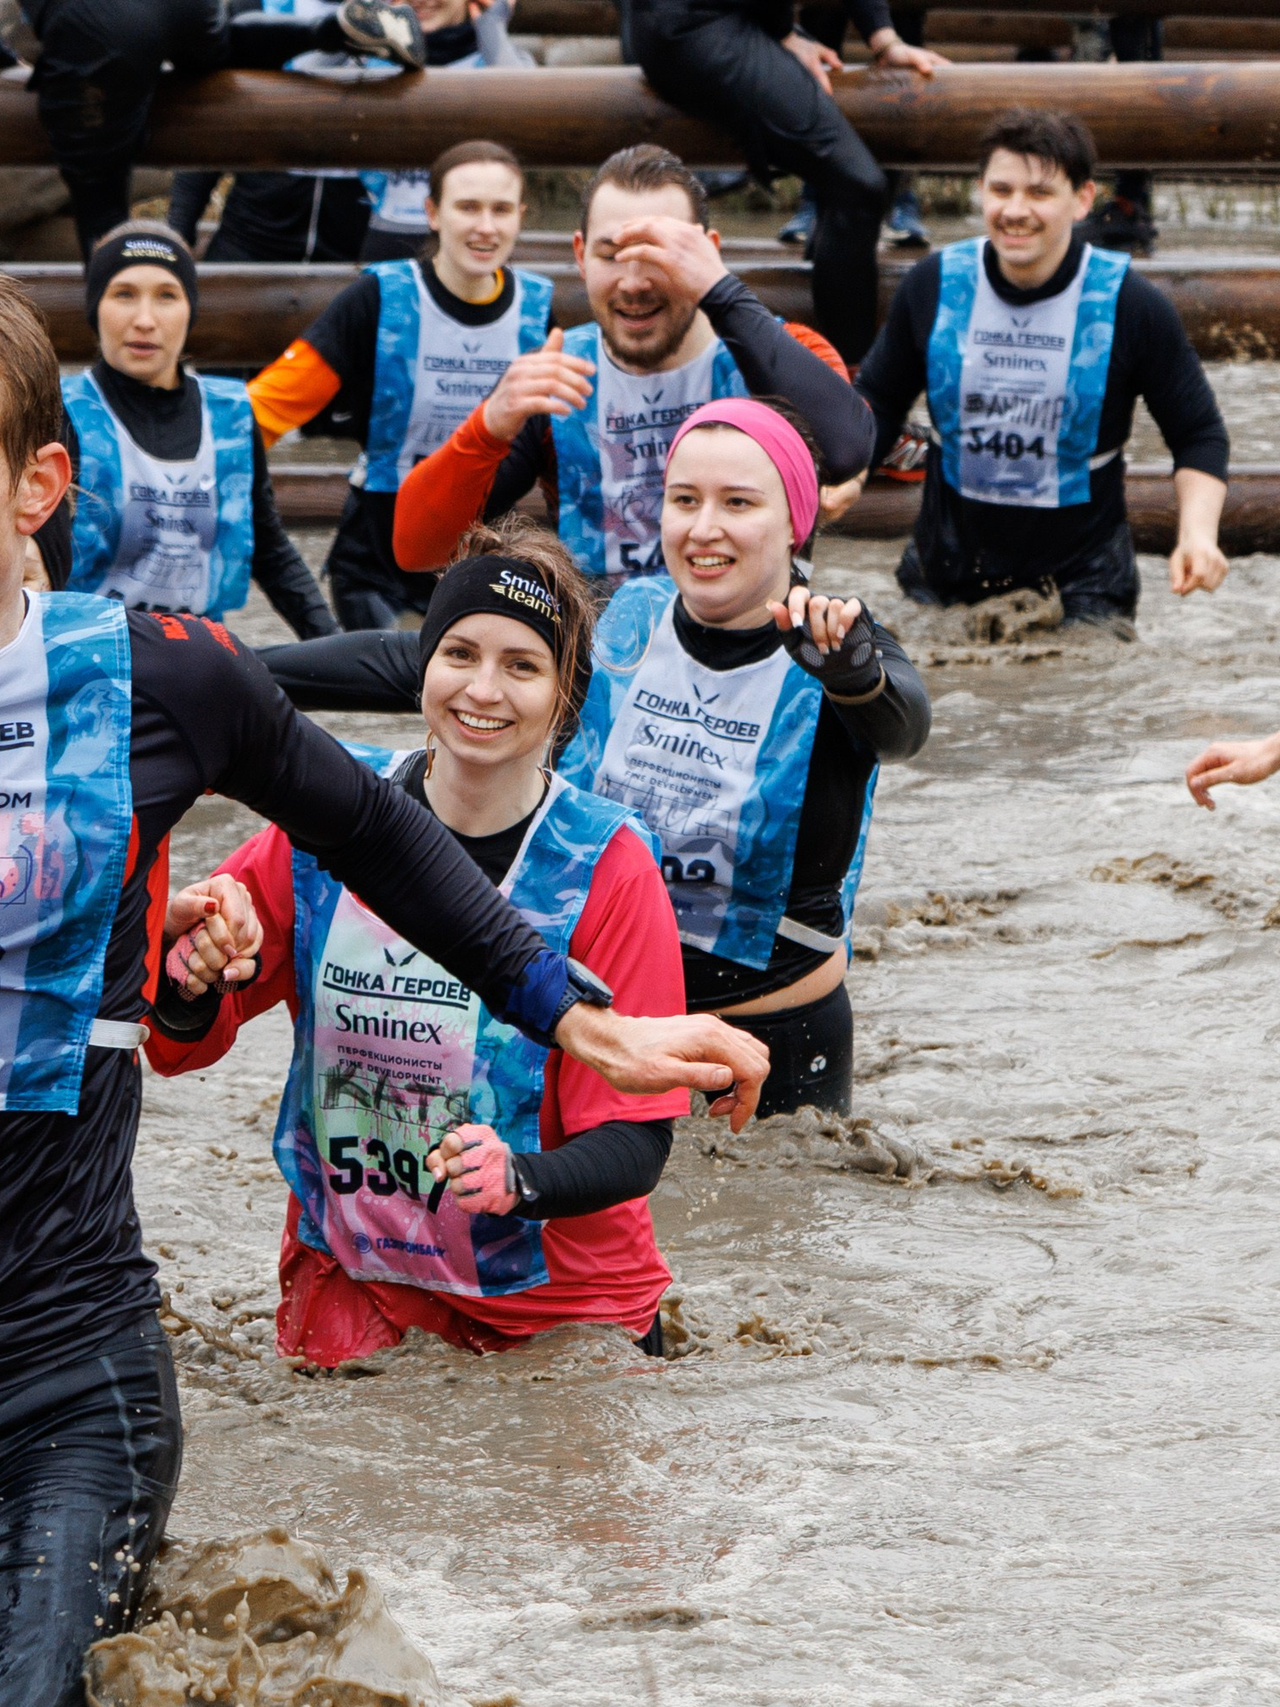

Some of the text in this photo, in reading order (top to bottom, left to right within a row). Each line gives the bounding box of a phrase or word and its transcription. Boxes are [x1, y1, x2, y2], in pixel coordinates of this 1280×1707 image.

[982, 350, 1048, 373] Sminex
[436, 378, 495, 398] Smine
[624, 437, 671, 462] Smin
[508, 586, 552, 619] team
[636, 689, 760, 738] ГОНКА ГЕРОЕВ
[636, 723, 729, 770] Sminex
[629, 757, 722, 789] ПЕРФЕКЦИОНИСТЫ
[323, 961, 472, 1003] ГОНКА ГЕРОЕВ
[335, 1004, 442, 1046] Sminex
[337, 1045, 442, 1071] ПЕРФЕКЦИОНИСТЫ
[338, 1058, 442, 1085] FINE DEVELOPMENT
[328, 1136, 451, 1215] 5397
